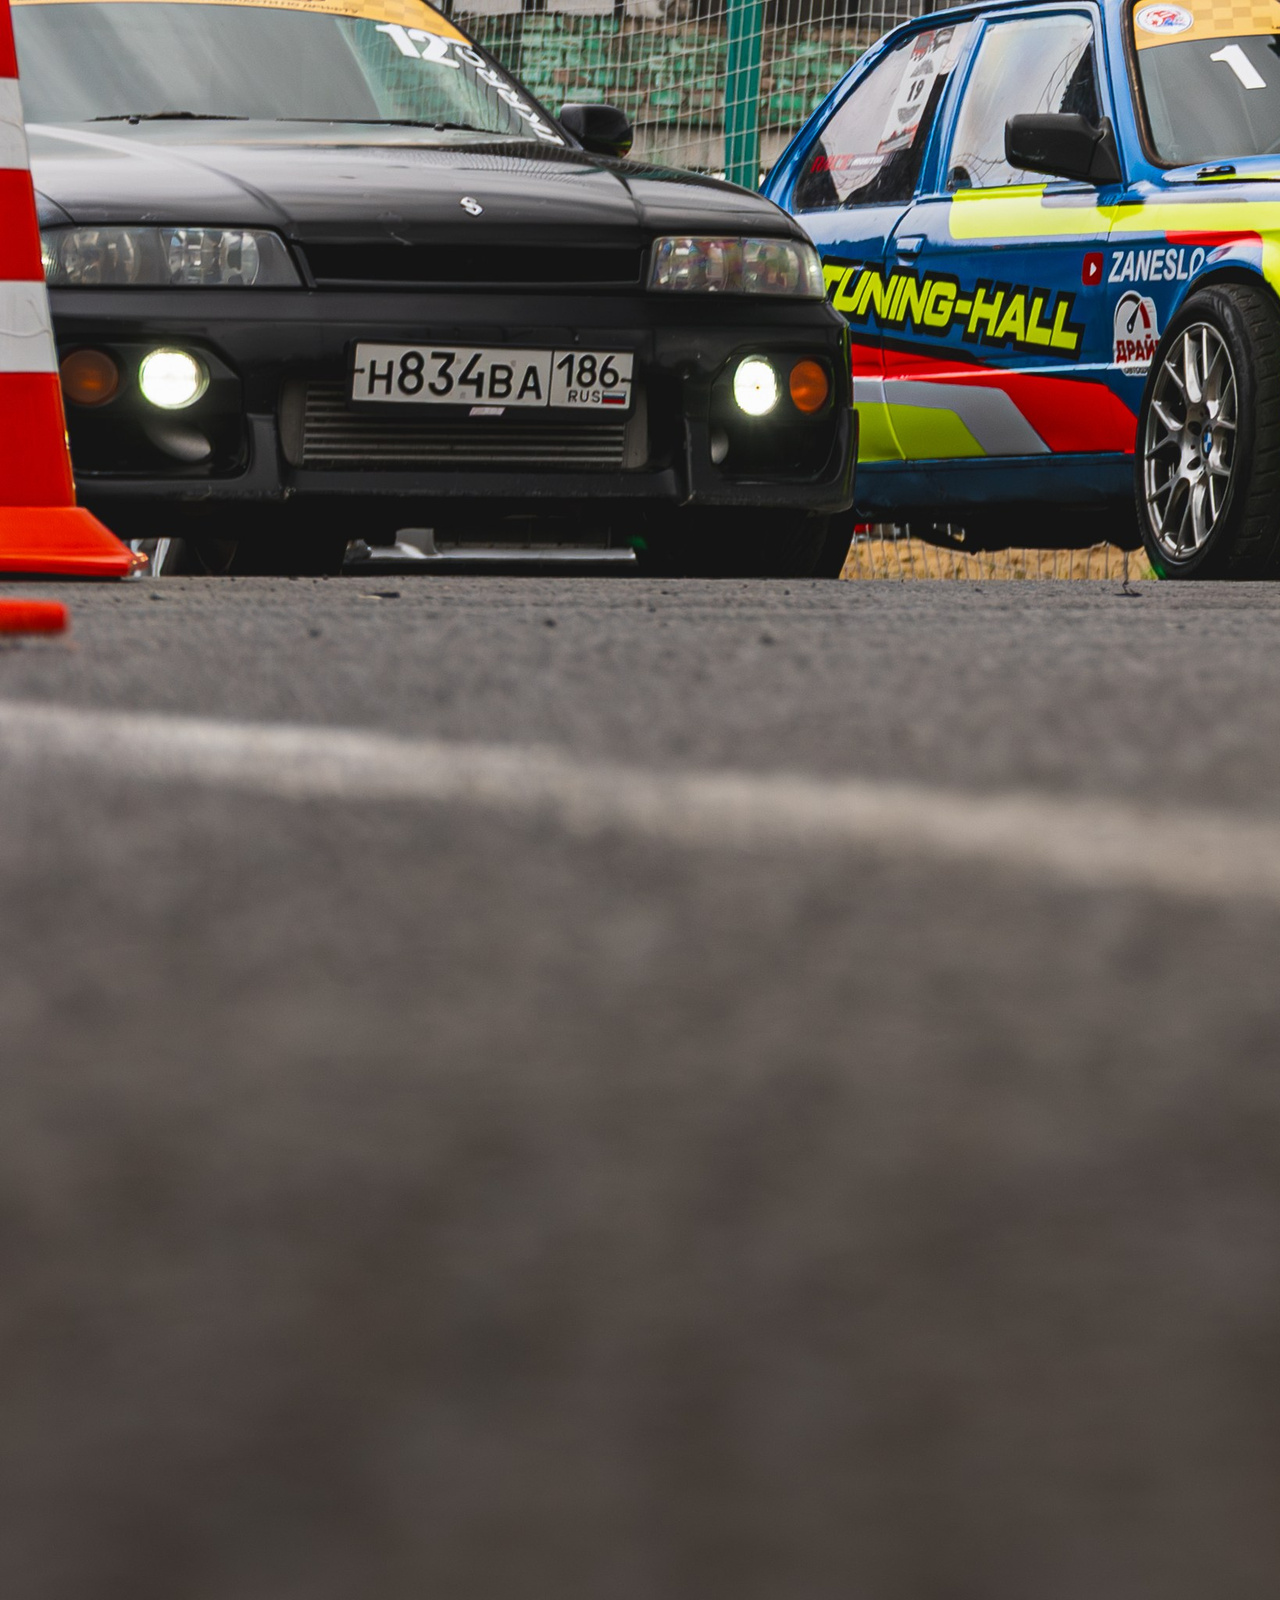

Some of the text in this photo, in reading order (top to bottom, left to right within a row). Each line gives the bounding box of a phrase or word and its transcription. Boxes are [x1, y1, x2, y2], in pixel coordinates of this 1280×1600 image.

[1210, 44, 1267, 89] 1
[906, 79, 925, 103] 19
[822, 264, 1079, 350] TUNING-HALL
[1116, 333, 1160, 364] ДРАЙ
[367, 351, 620, 400] Н834ВА 186
[567, 390, 601, 403] RUS
